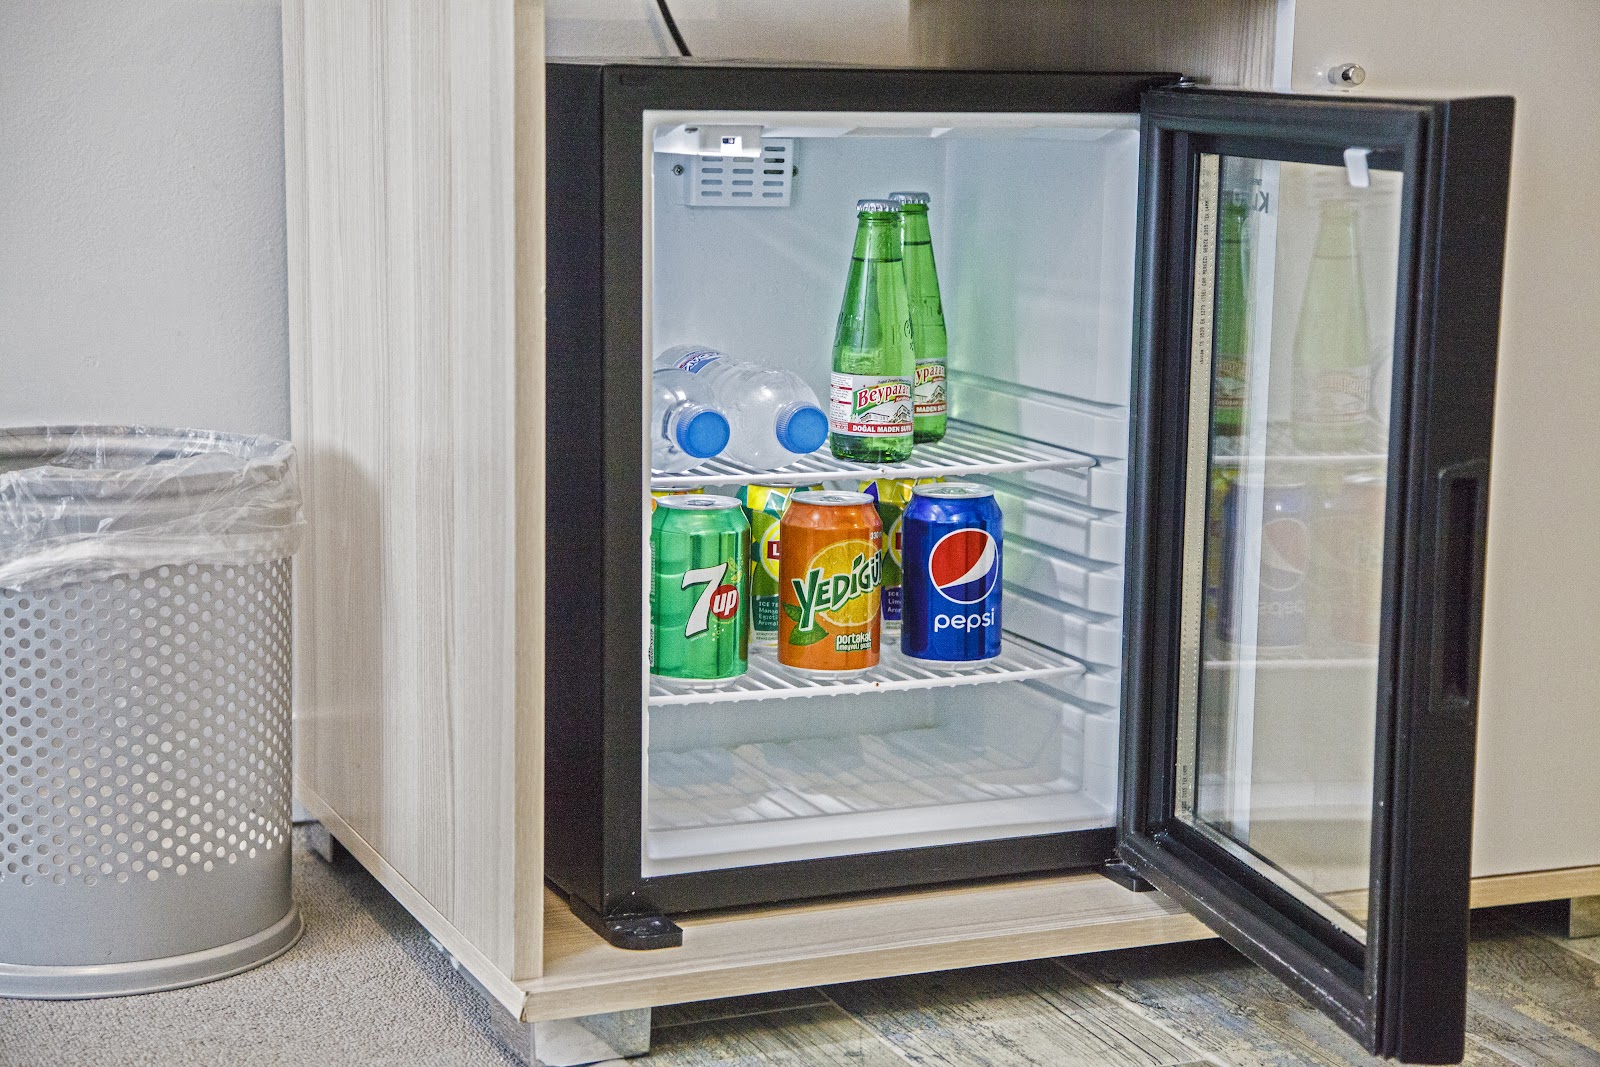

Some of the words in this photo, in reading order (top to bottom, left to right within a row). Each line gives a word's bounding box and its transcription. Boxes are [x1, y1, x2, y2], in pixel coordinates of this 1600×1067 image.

[852, 423, 876, 433] DOĞAL
[877, 425, 900, 433] MADEN
[933, 607, 996, 633] pepsi
[836, 630, 872, 651] portakal
